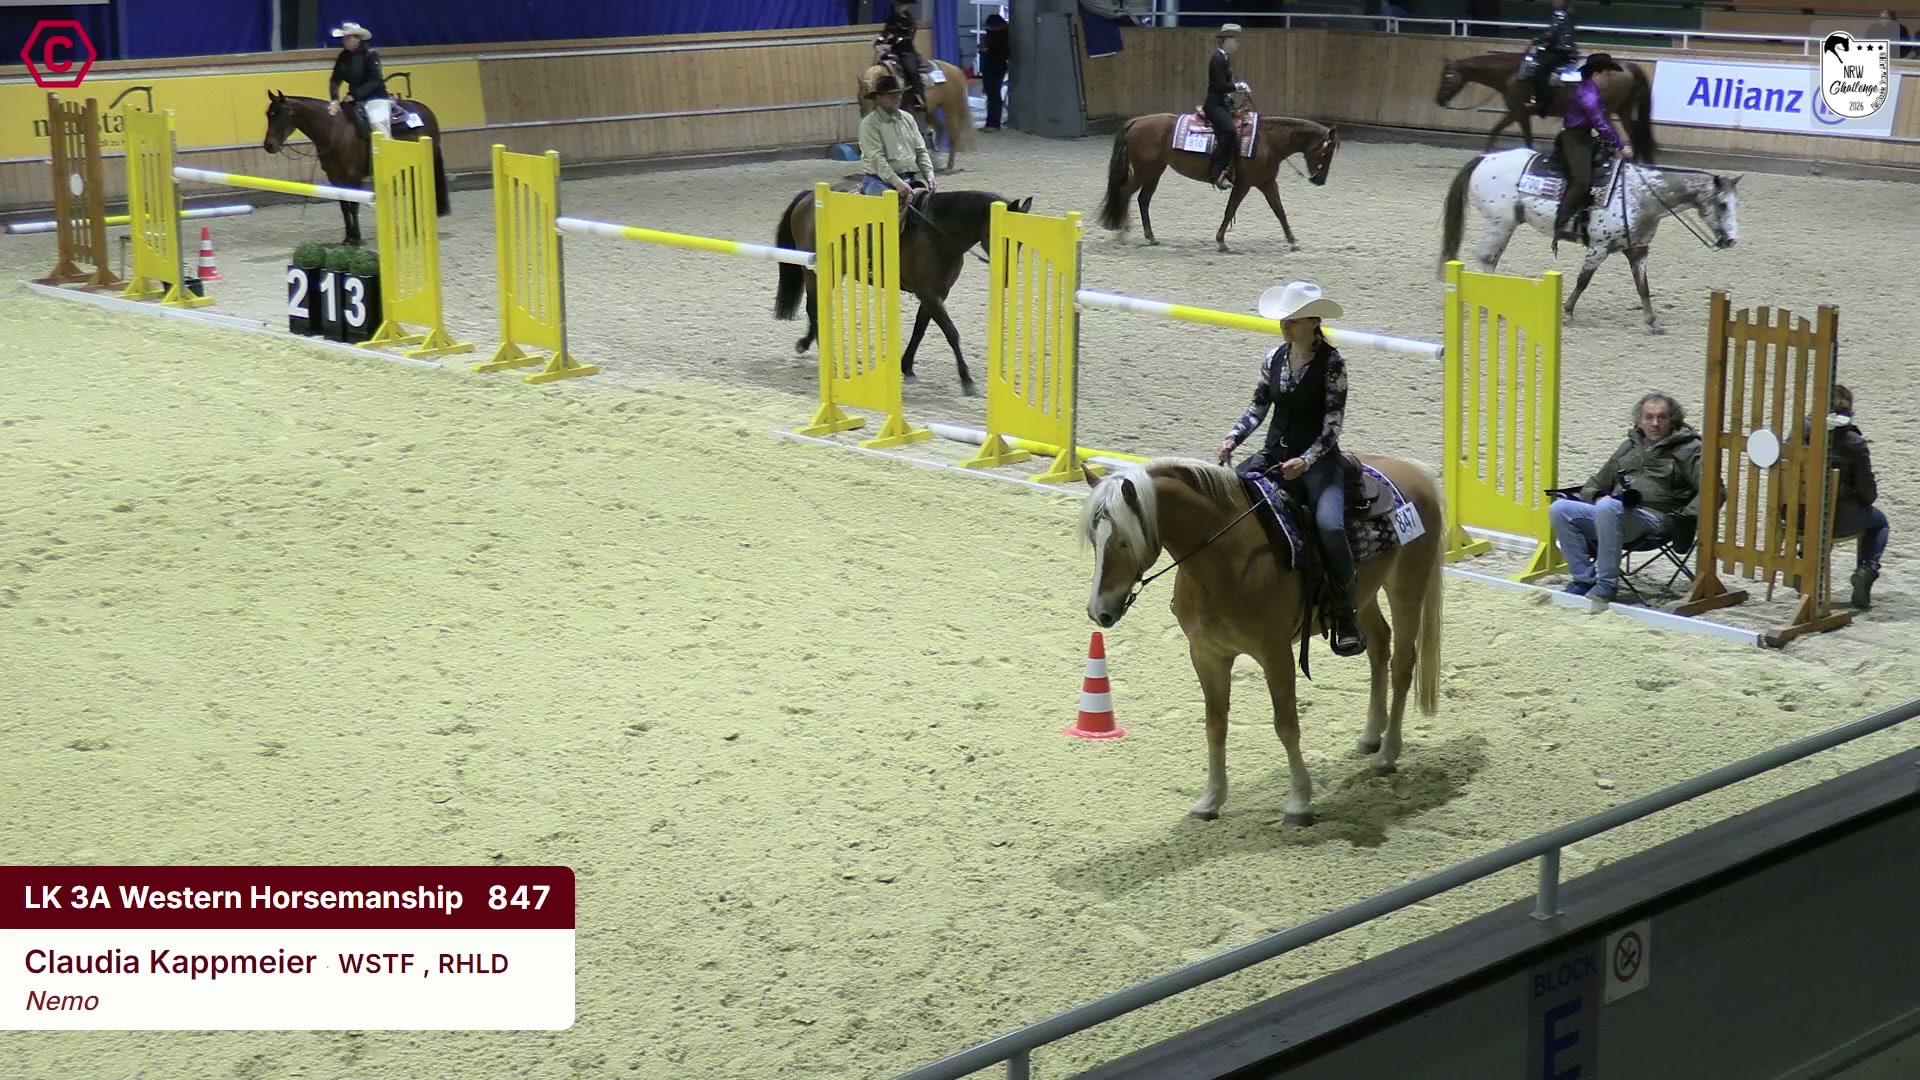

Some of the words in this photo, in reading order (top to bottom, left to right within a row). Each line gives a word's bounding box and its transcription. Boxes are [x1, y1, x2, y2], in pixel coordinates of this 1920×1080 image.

[1687, 76, 1804, 114] Allianz
[288, 268, 309, 318] 2
[320, 272, 337, 322] 1
[344, 277, 367, 327] 3
[1395, 506, 1417, 534] 847
[1534, 953, 1599, 998] BLOCK
[1543, 996, 1583, 1080] E
